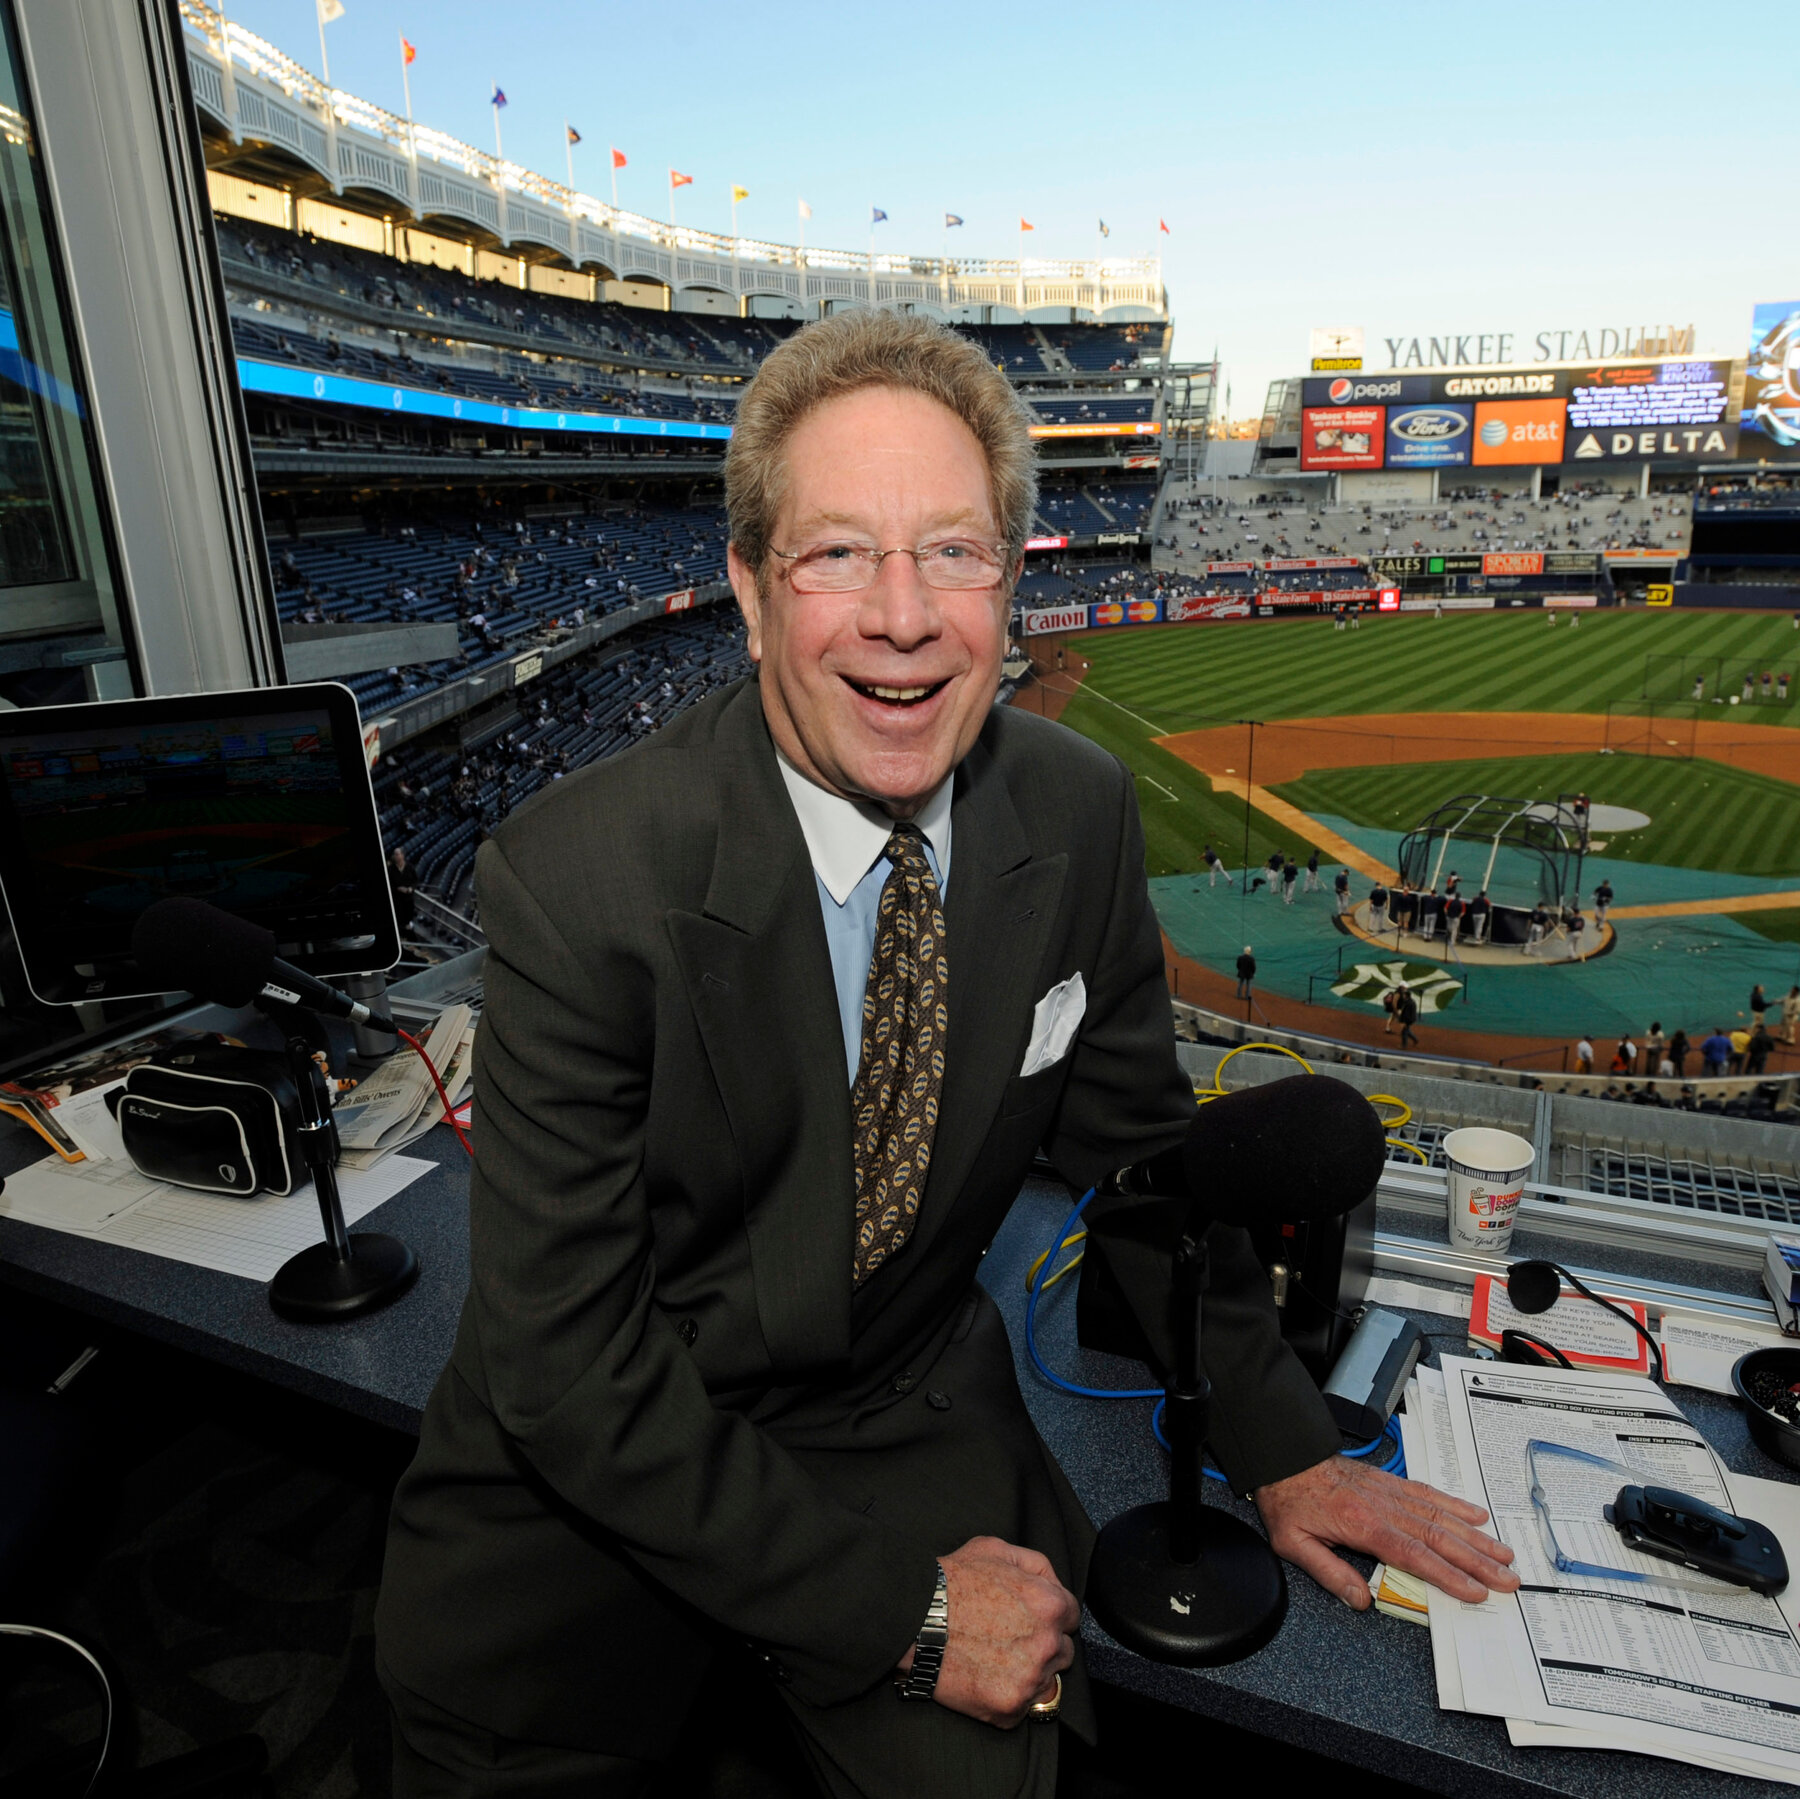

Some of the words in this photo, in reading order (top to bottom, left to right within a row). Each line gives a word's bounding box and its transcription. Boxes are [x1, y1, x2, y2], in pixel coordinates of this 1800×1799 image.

[1384, 333, 1514, 369] YANKEE
[1535, 324, 1696, 362] STADIUM
[1685, 361, 1710, 371] YOU
[1445, 374, 1555, 396] GATORADE
[1661, 370, 1713, 383] KNOW?
[1353, 380, 1402, 400] pepsi
[1407, 415, 1450, 436] Ford
[1511, 418, 1559, 442] at&t
[1404, 444, 1429, 453] Drive
[1431, 444, 1451, 453] one.
[1611, 430, 1727, 455] DELTA
[1376, 557, 1421, 571] ZALES
[1485, 554, 1540, 567] SPORTS
[1178, 596, 1240, 619] Budweiser
[1026, 607, 1084, 632] Canon
[374, 1088, 402, 1100] Owens
[1457, 1228, 1474, 1242] New
[1474, 1235, 1495, 1248] York
[1489, 1304, 1553, 1326] MERCEDES-BENZ
[1569, 1306, 1591, 1315] KEYS
[1592, 1310, 1604, 1318] TO
[1605, 1311, 1621, 1321] THE
[1579, 1315, 1592, 1323] BY
[1592, 1317, 1616, 1327] YOUR
[1488, 1310, 1522, 1325] DEALERS
[1530, 1323, 1542, 1331] ON
[1543, 1325, 1559, 1333] THE
[1560, 1327, 1579, 1337] WEB
[1580, 1330, 1592, 1339] AT
[1593, 1333, 1627, 1345] SEARCH
[1530, 1328, 1546, 1338] DOT
[1574, 1338, 1598, 1347] YOUR
[1599, 1342, 1633, 1352] SOURCE
[1555, 1342, 1625, 1356] MERCEDES-BENZ
[1492, 1400, 1515, 1408] LESTER,
[1521, 1399, 1555, 1409] TONIGHT'S
[1583, 1406, 1615, 1415] STARTING
[1615, 1410, 1645, 1418] PITCHER
[1665, 1437, 1697, 1447] NUMBERS
[1558, 1588, 1612, 1599] BATTER-PITCHER
[1612, 1595, 1648, 1606] MATCHUPS
[1690, 1612, 1720, 1623] STARTING
[1544, 1667, 1590, 1679] 18-DAISUKE
[1591, 1673, 1639, 1687] MATSUZAKA,
[1641, 1682, 1657, 1690] RHP
[1763, 1709, 1780, 1717] 6.80
[1782, 1712, 1800, 1721] ERA,
[1602, 1668, 1659, 1684] TOMORROW'S
[1659, 1679, 1675, 1687] RED
[1676, 1682, 1693, 1692] SOX
[1693, 1687, 1734, 1701] STARTING
[1735, 1695, 1771, 1709] PITCHER
